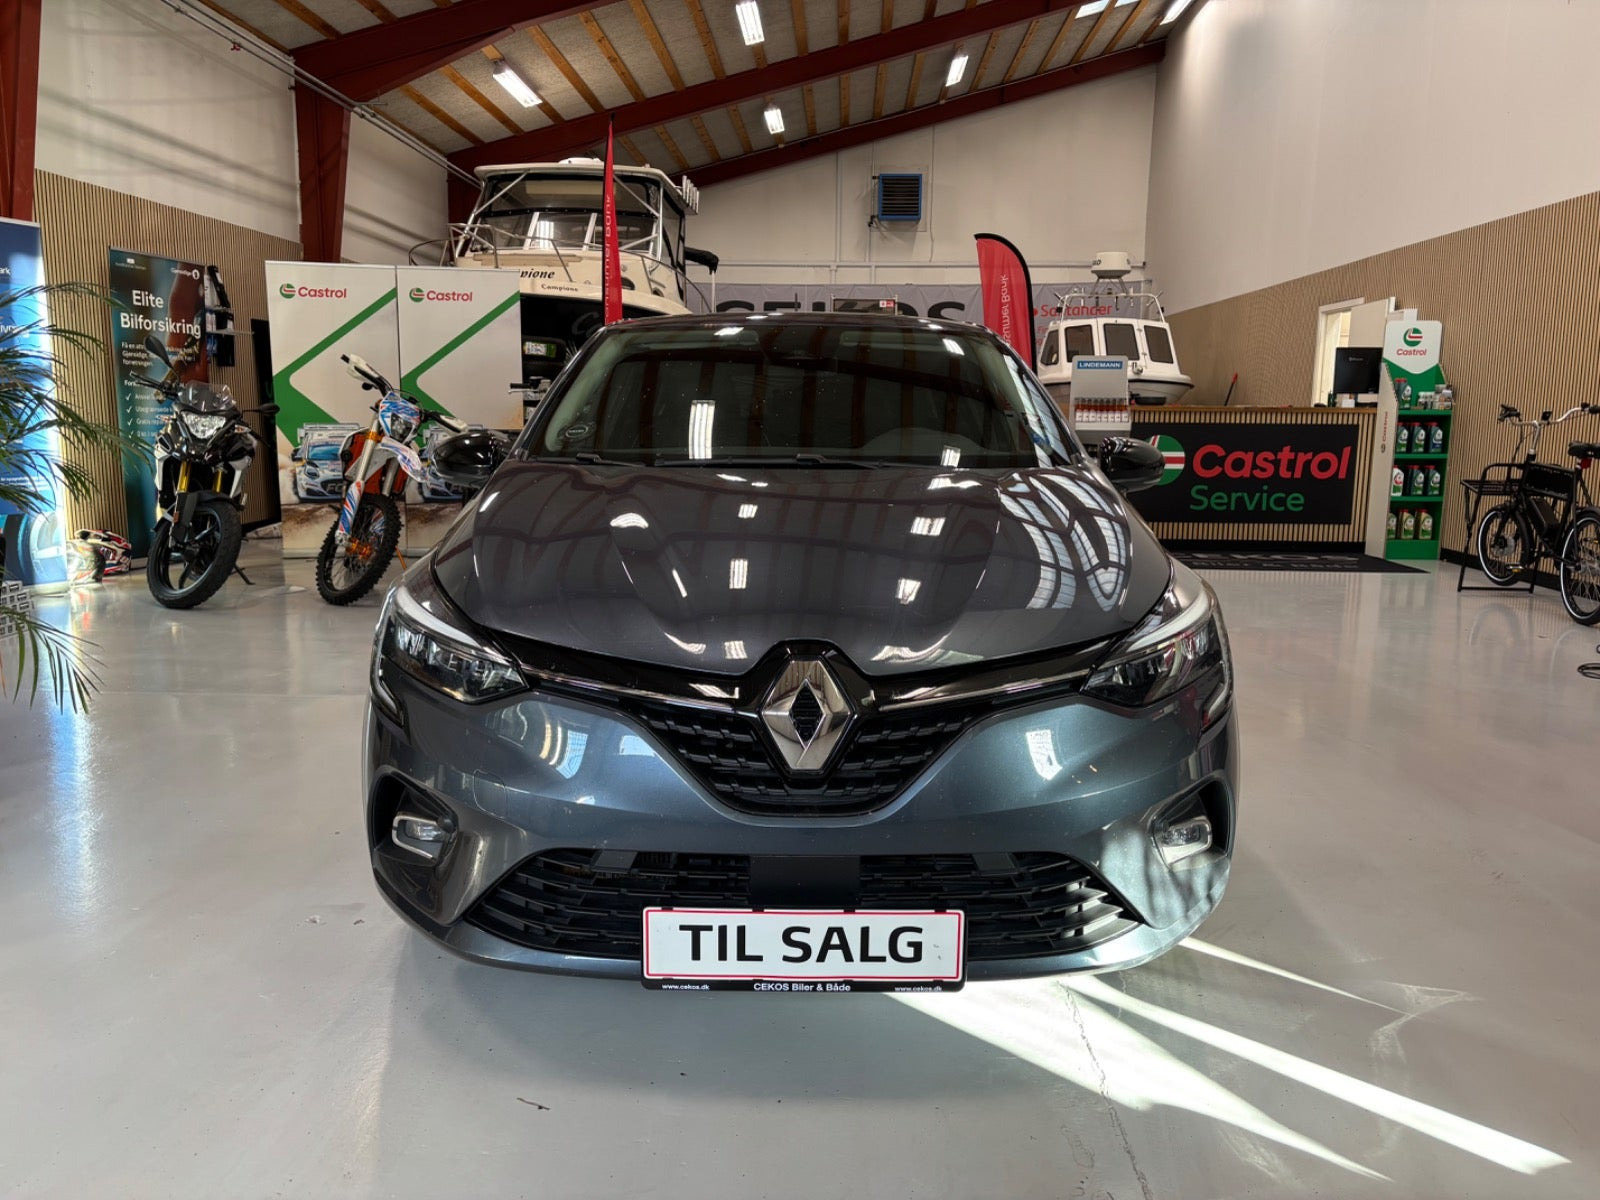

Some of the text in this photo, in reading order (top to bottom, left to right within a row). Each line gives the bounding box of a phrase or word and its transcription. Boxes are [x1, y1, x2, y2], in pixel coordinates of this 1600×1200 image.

[132, 290, 164, 308] Elite
[298, 286, 347, 299] Castrol
[426, 290, 473, 302] Castrol
[120, 312, 201, 339] Bilforsikring
[1396, 348, 1427, 356] Castrol
[1192, 444, 1352, 480] Castrol
[1189, 484, 1305, 512] Service
[679, 924, 924, 963] TIL SALG
[661, 983, 710, 991] www.cekos.dk
[753, 982, 851, 991] CEKOS Biler & Både
